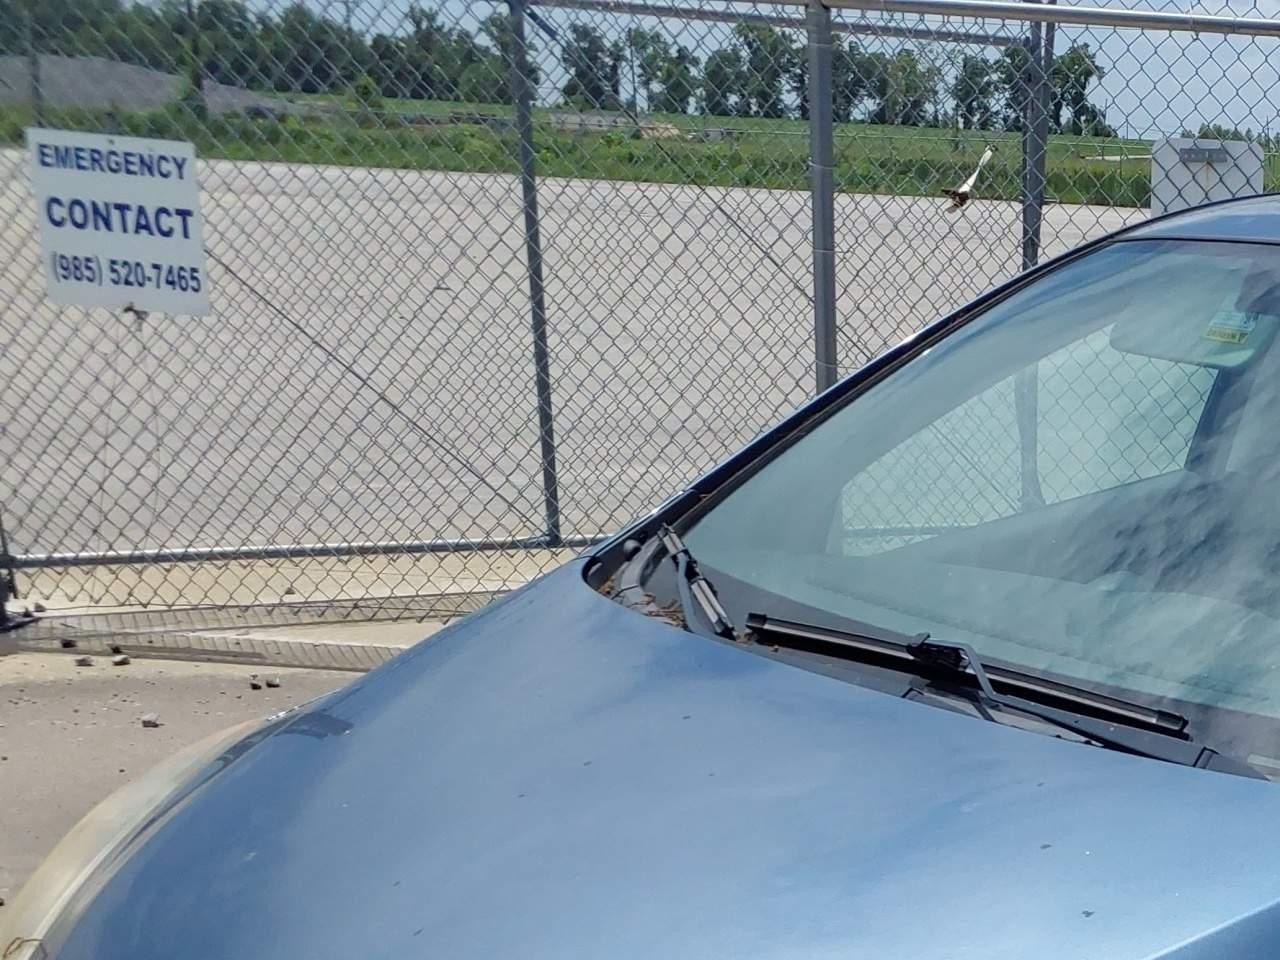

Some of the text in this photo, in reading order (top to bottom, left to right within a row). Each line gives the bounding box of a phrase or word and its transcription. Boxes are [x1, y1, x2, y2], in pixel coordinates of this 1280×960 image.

[38, 143, 188, 180] EMERGENCY
[46, 197, 194, 239] CONTACT
[52, 251, 202, 293] (985) 520-7465
